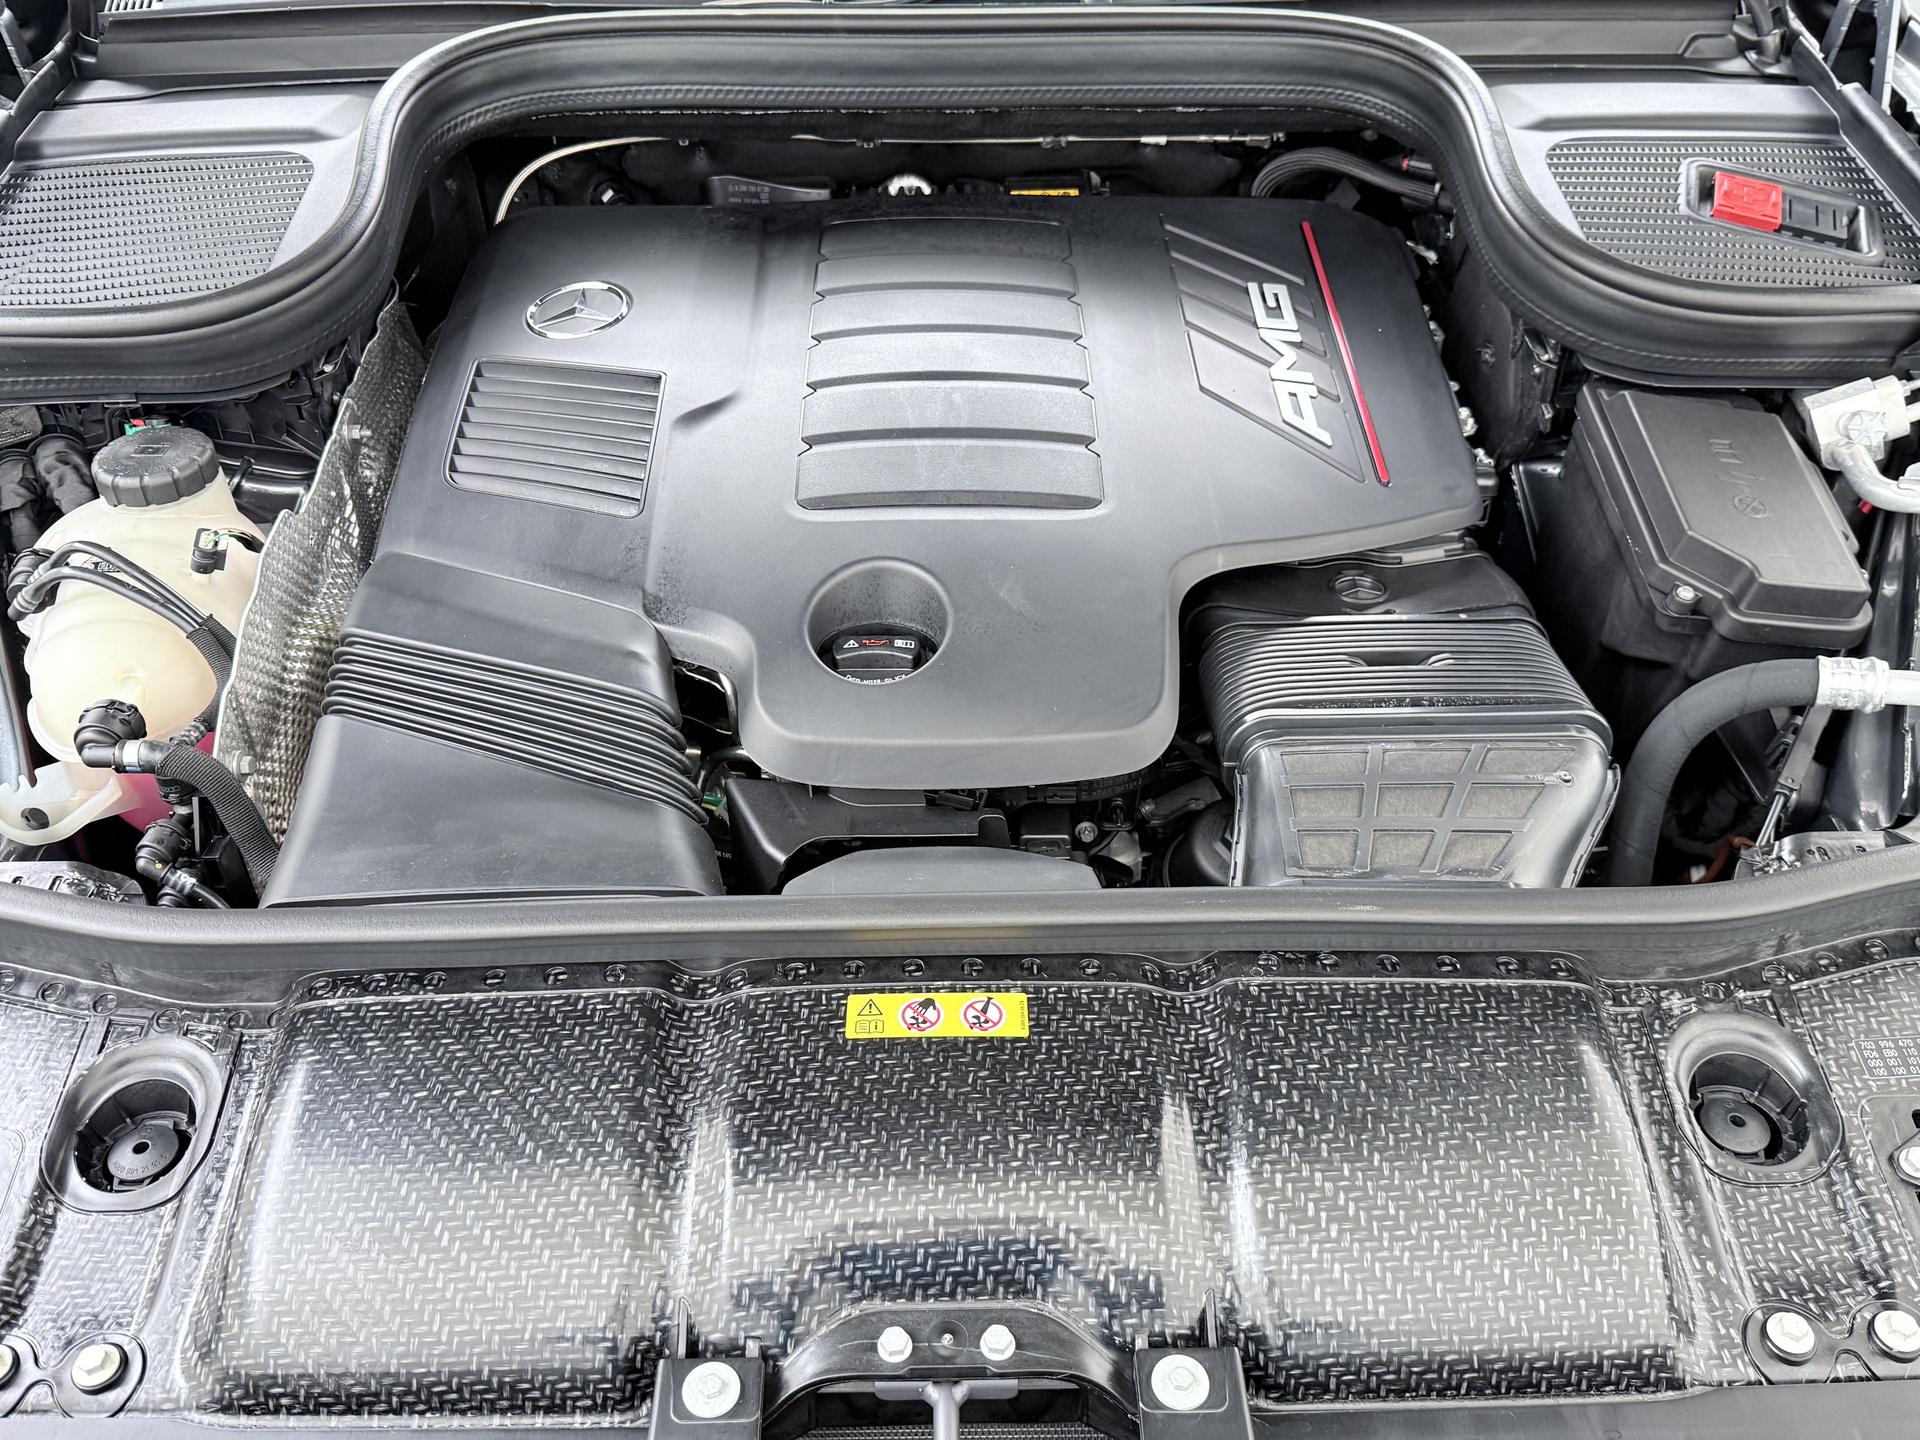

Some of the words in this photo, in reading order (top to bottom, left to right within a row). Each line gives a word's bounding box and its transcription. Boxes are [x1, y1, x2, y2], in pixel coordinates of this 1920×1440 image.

[1247, 282, 1333, 447] AMG
[1859, 1042, 1875, 1050] 703
[1878, 1041, 1894, 1049] 996
[1902, 1048, 1917, 1056] 110
[1867, 1059, 1883, 1067] 000
[1886, 1058, 1901, 1066] 001
[1872, 1068, 1887, 1076] 100
[1891, 1067, 1906, 1075] 100
